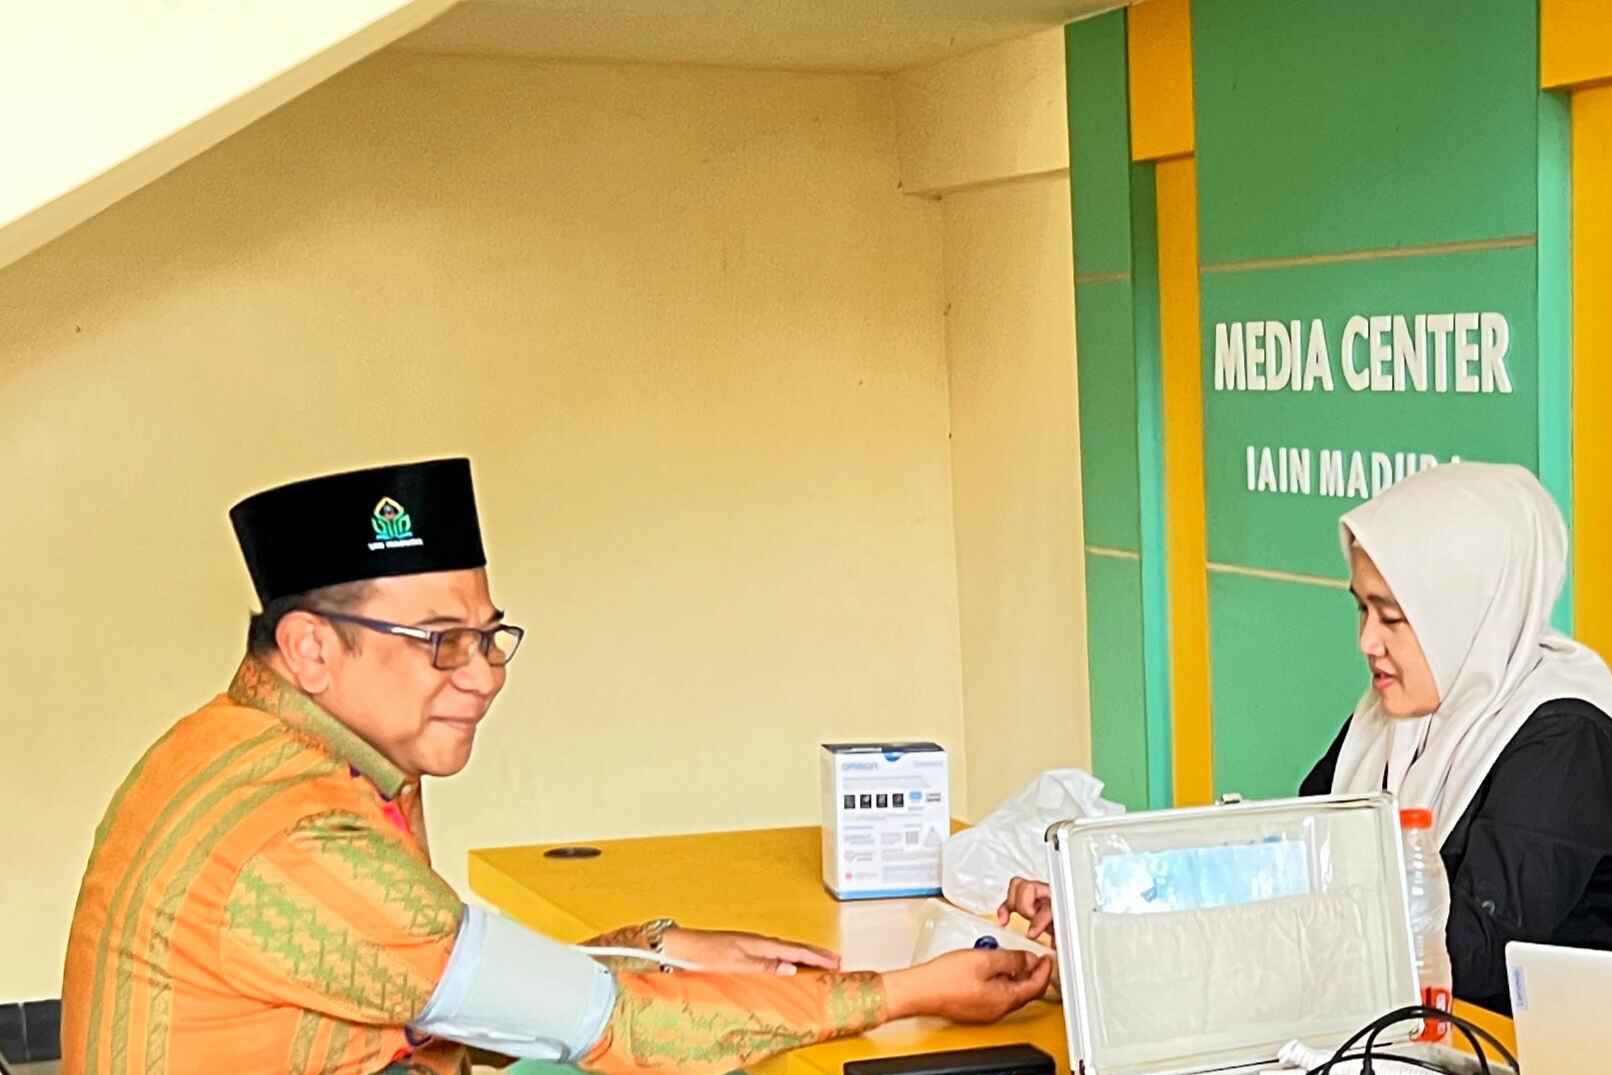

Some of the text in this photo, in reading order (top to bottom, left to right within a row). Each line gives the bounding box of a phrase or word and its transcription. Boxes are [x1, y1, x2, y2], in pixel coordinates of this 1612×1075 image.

[1214, 312, 1513, 393] MEDIA CENTER
[1246, 445, 1461, 499] IAIN MADU
